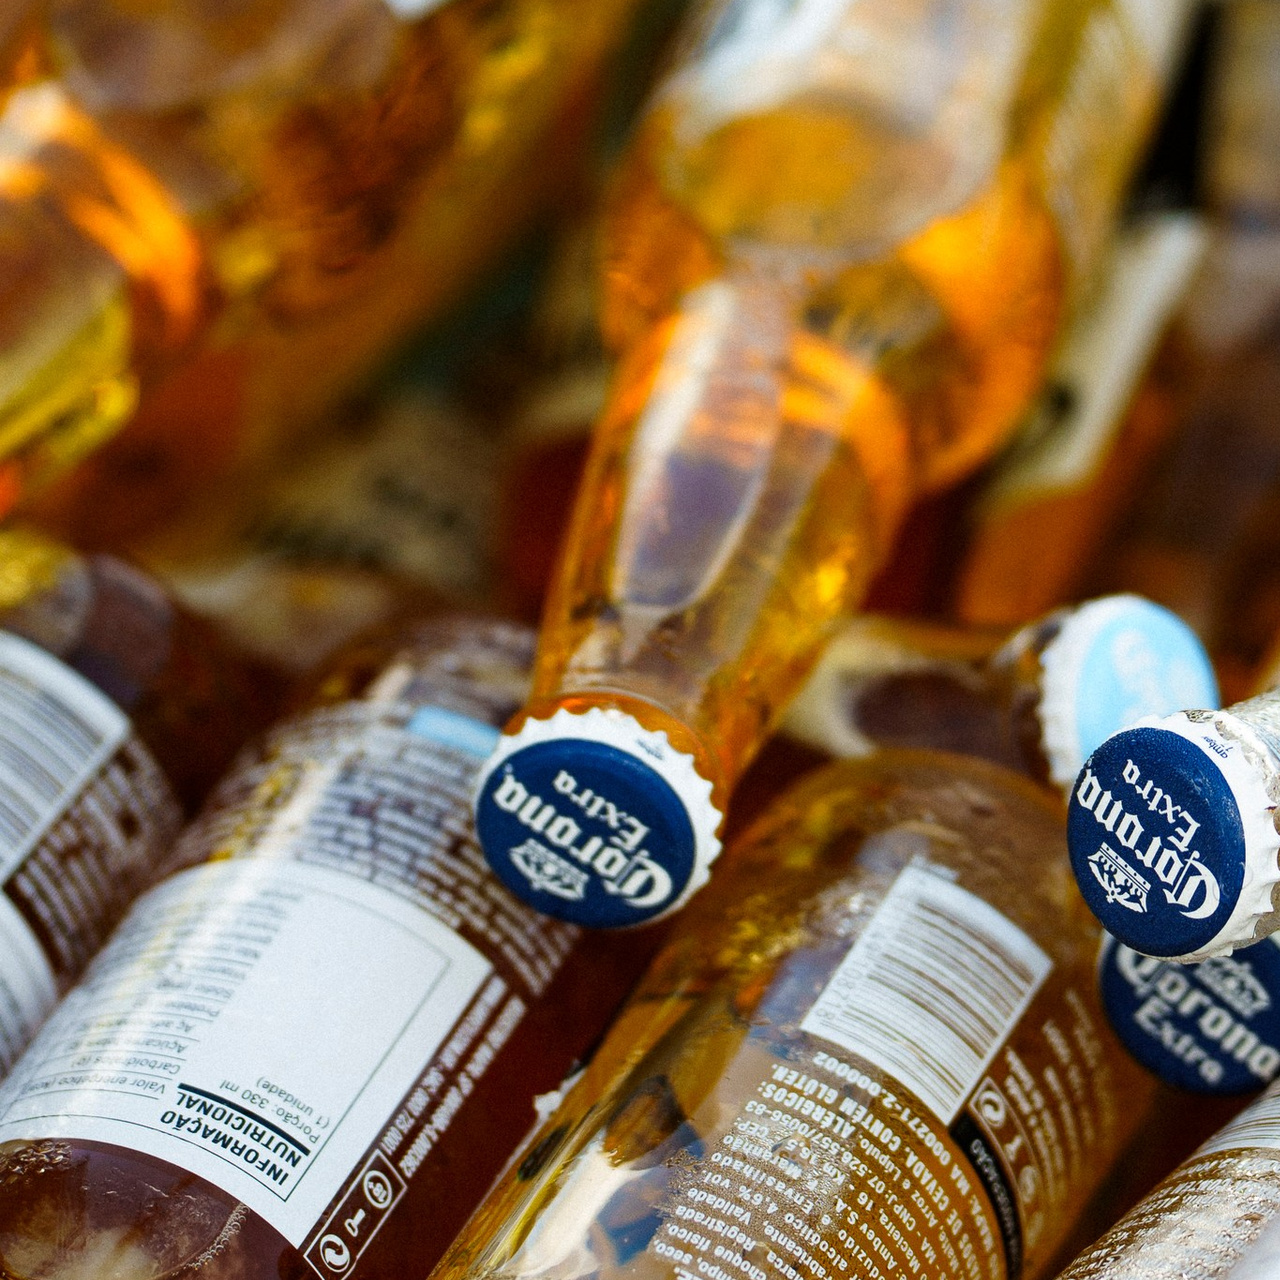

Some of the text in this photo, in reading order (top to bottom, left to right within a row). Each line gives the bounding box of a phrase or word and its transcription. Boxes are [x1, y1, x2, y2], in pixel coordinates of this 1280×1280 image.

[553, 770, 650, 853] Extra
[1122, 759, 1200, 852] Extra
[492, 773, 673, 908] Corona
[1076, 769, 1221, 919] Corona
[1134, 994, 1225, 1084] Extra
[219, 1078, 321, 1144] Porção: 330 ml
[254, 1075, 314, 1116] unidade)
[756, 1079, 856, 1137] ALÉRGICOS:
[159, 1109, 289, 1186] INFORMAÇÃO
[173, 1090, 302, 1169] NUTRICIONAL
[772, 1062, 962, 1235] DE CEVADA. CONTÉM GLÚTEN.
[703, 1169, 729, 1188] vol.
[856, 1133, 901, 1181] Lúpulo.
[948, 1163, 971, 1197] MA
[687, 1186, 750, 1225] Validade
[711, 1150, 813, 1213] Envasilhado
[855, 1190, 873, 1212] 16
[900, 1177, 912, 1190] e
[674, 1204, 756, 1251] Registrada
[818, 1212, 832, 1227] e
[883, 1191, 916, 1231] CNPJ:
[910, 1189, 938, 1227] Arroz
[783, 1210, 848, 1272] alcoólico
[859, 1221, 897, 1269] Ambev
[919, 1237, 936, 1264] MA
